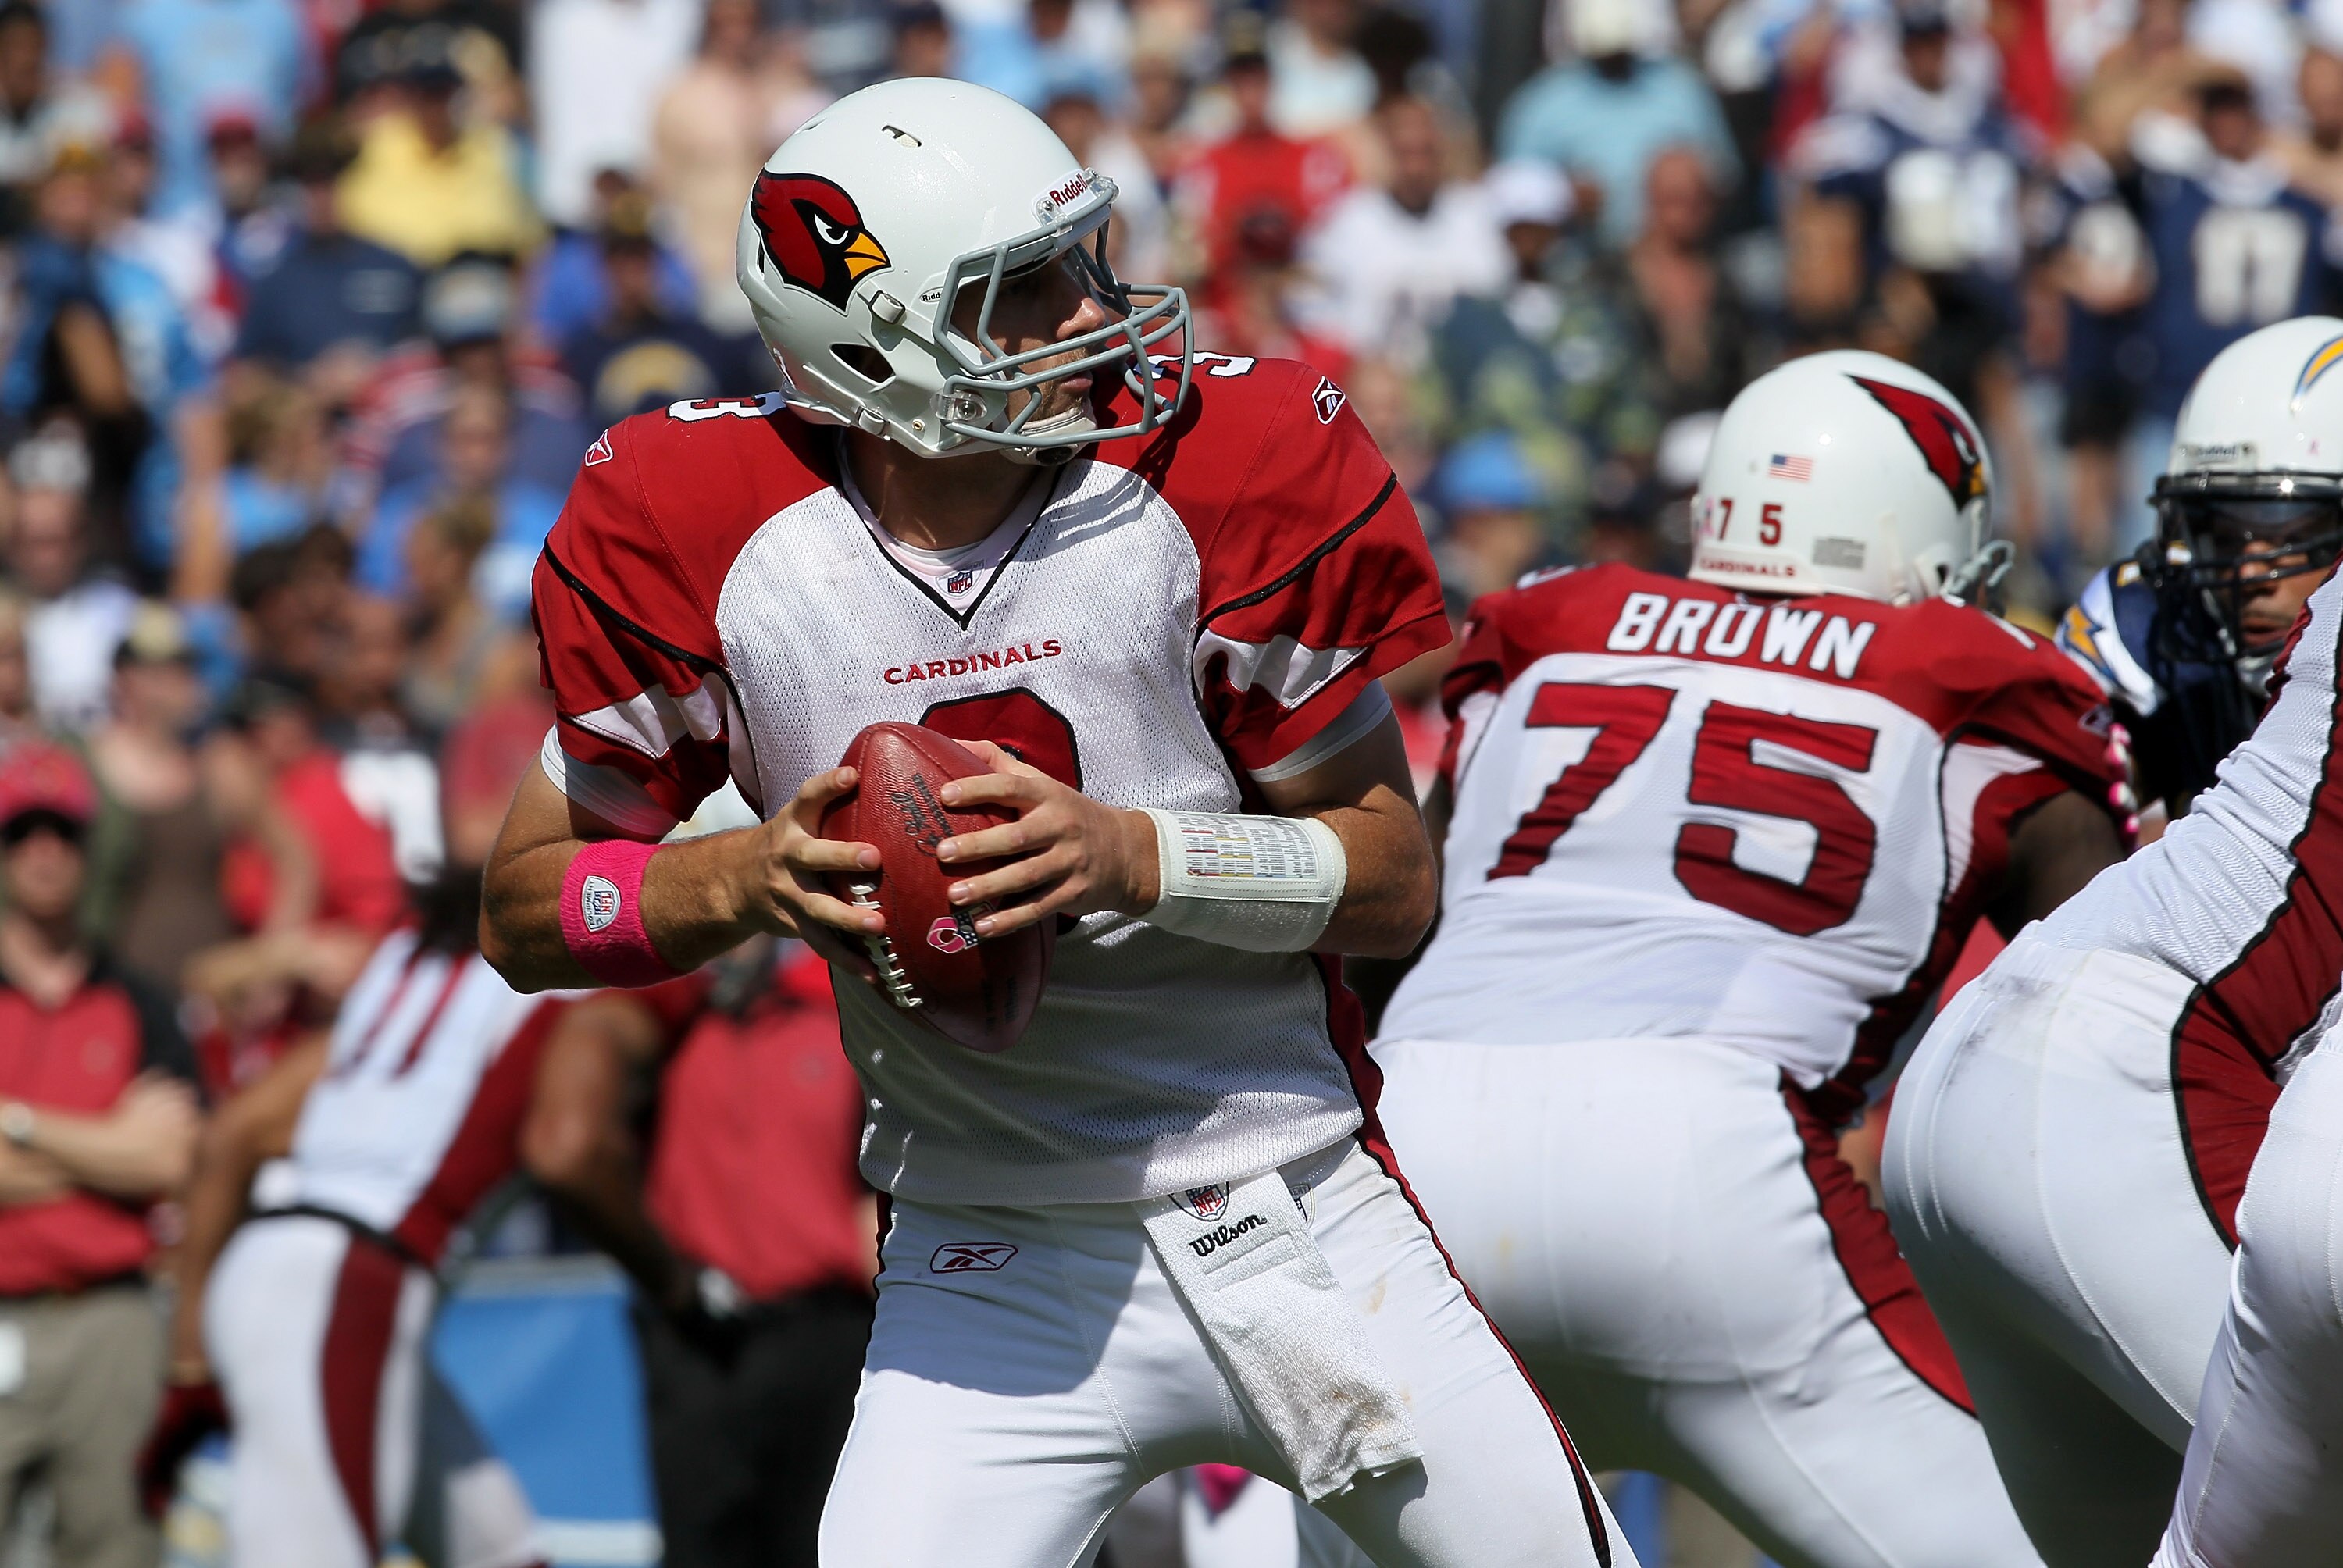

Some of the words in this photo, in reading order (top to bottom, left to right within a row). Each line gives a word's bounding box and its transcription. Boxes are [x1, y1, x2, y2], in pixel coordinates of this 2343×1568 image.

[1049, 173, 1088, 208] Riddell
[922, 291, 942, 301] Ridd
[950, 578, 972, 591] NFL
[1606, 592, 1876, 679] BROWN
[883, 640, 1061, 685] CARDINALS
[1487, 682, 1880, 938] 75
[586, 881, 595, 925] EQUIPMENT
[601, 893, 612, 914] NFL
[1193, 1191, 1221, 1215] NFL
[1189, 1214, 1261, 1256] Wilson
